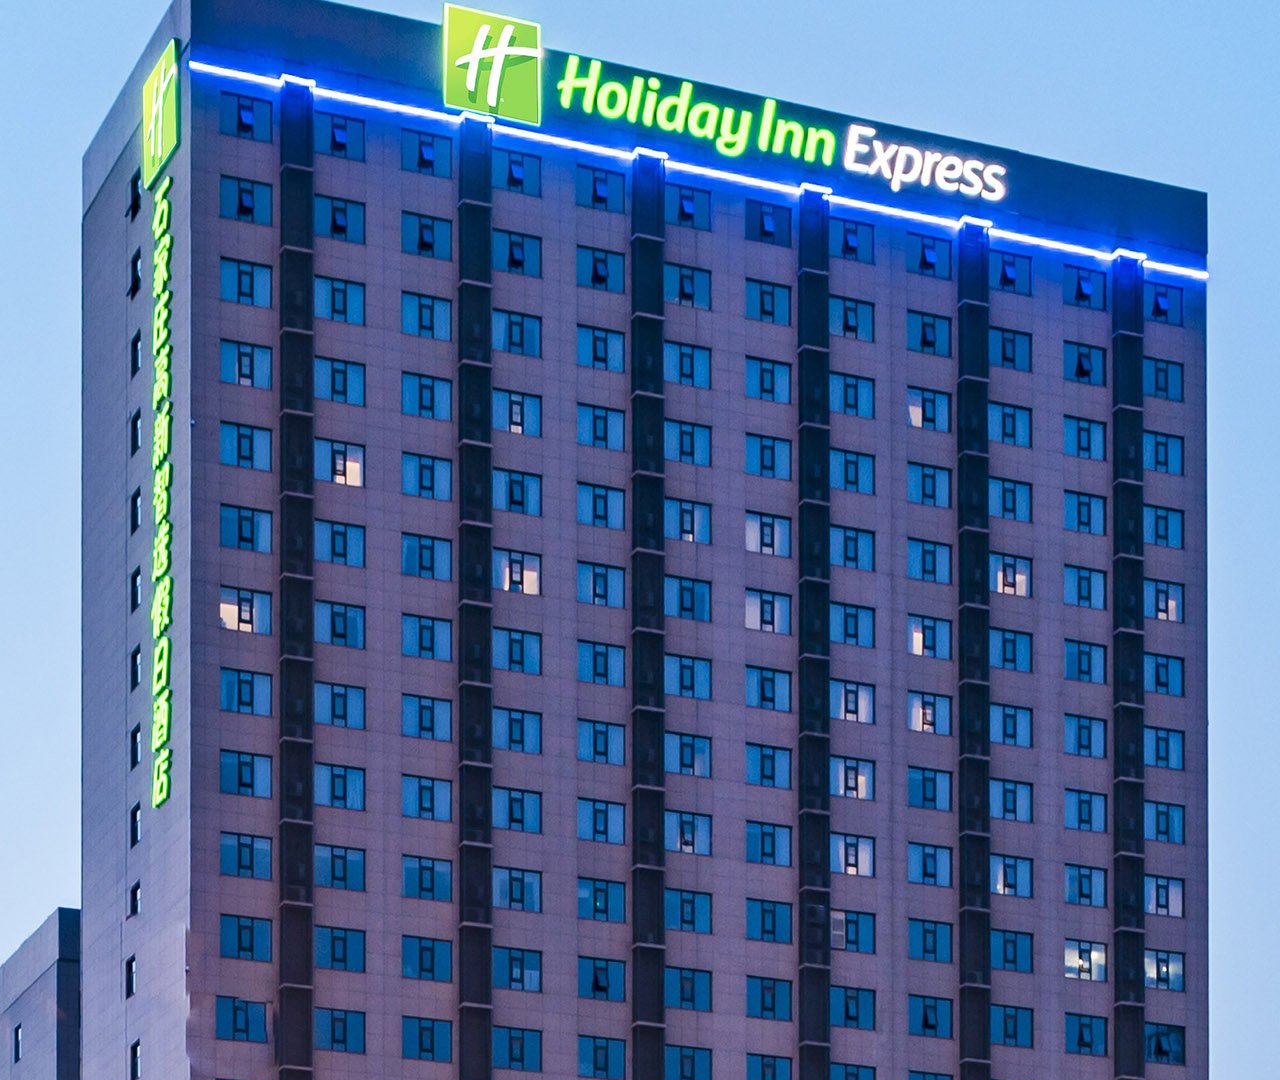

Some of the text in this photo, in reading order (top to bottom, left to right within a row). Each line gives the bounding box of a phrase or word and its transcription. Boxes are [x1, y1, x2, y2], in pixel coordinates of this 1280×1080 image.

[558, 54, 1008, 201] Holiday Inn Express
[152, 175, 170, 808] 石家庄高新智选假日酒店
